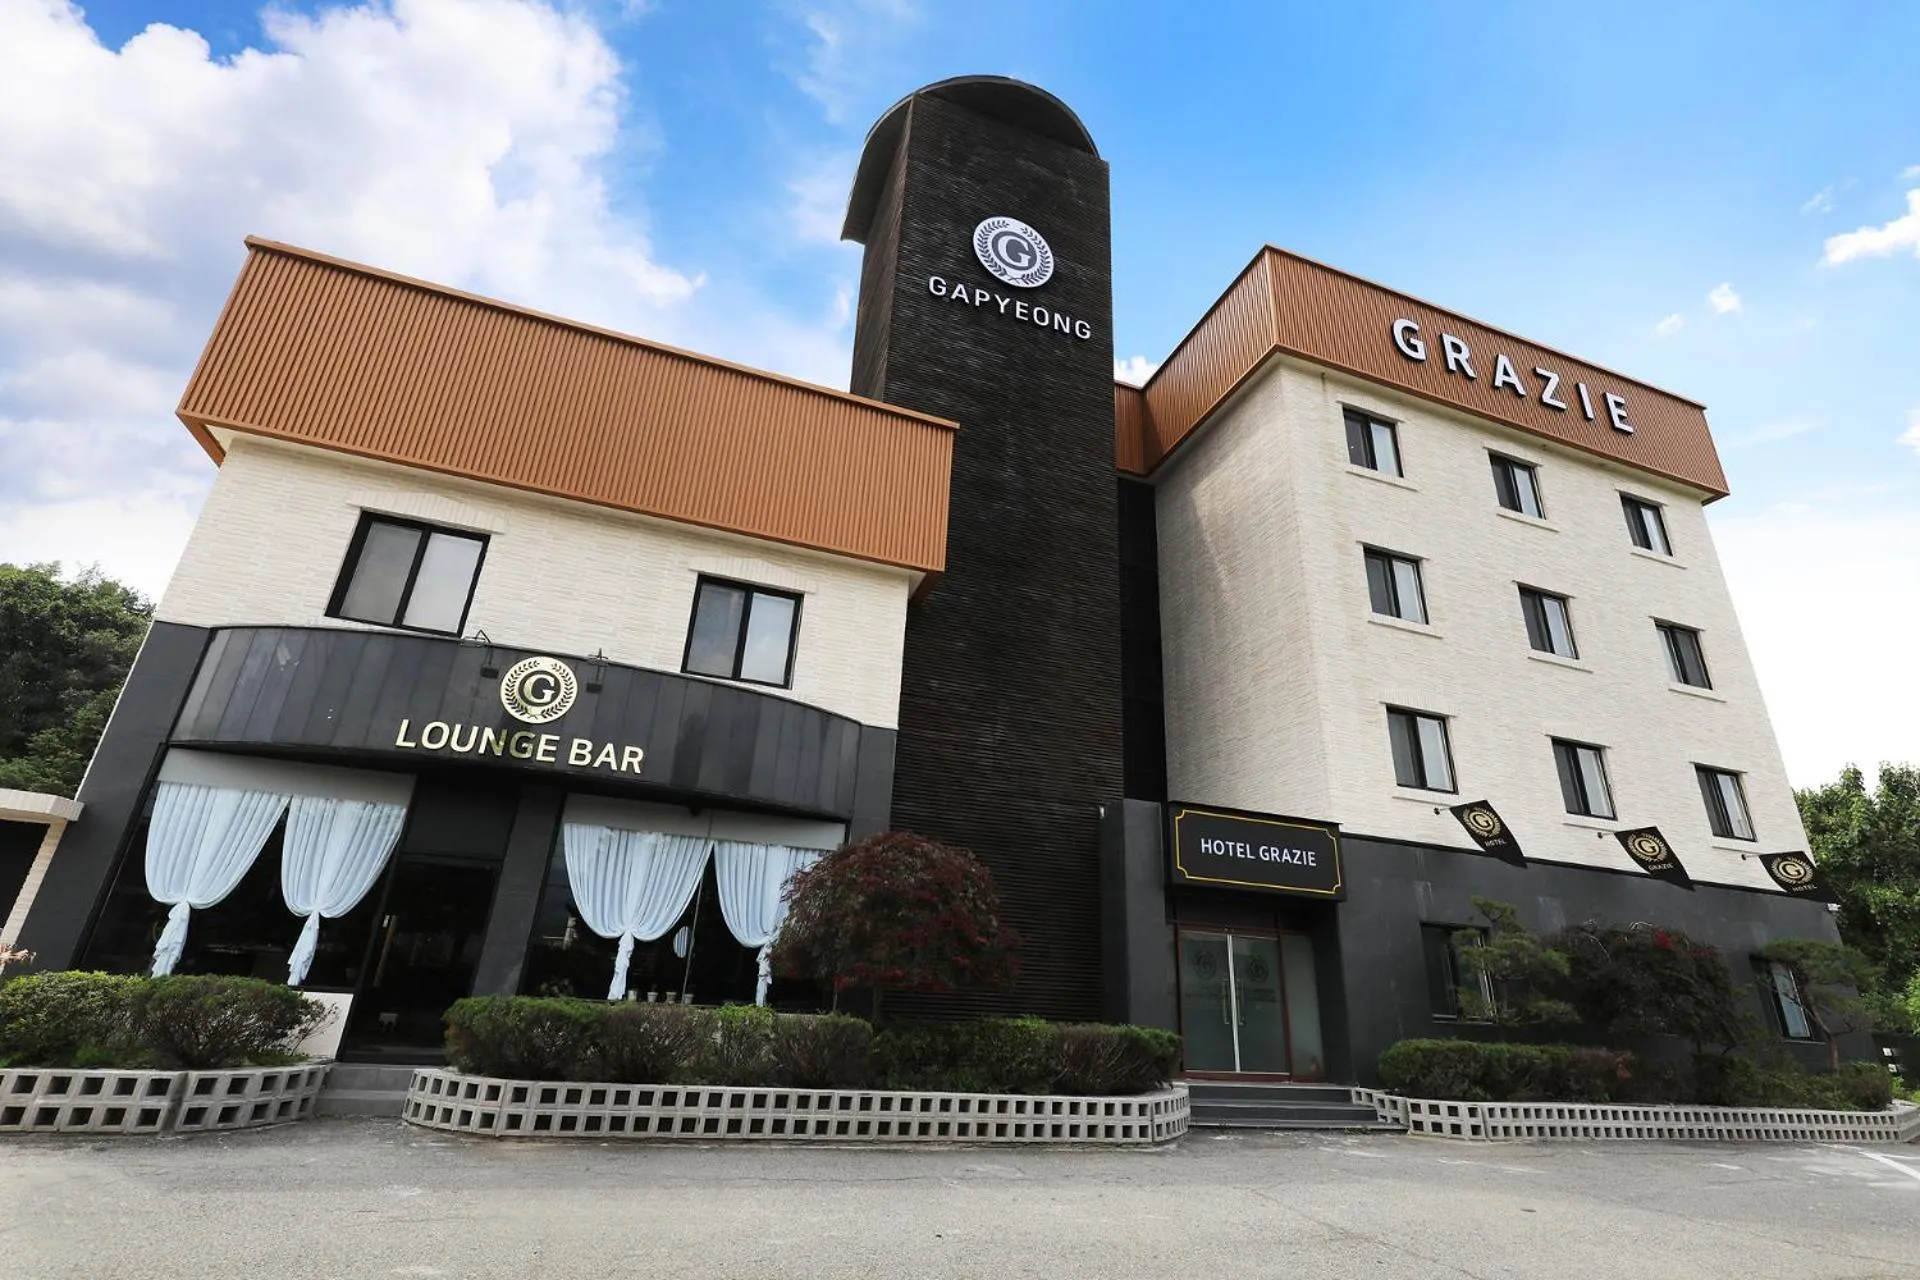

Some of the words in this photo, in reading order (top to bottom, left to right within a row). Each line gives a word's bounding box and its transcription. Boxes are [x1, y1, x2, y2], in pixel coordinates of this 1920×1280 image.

[997, 234, 1032, 268] G
[928, 276, 1091, 339] GAPYEONG
[1392, 318, 1634, 434] GRAZIE
[522, 674, 556, 703] G
[395, 718, 560, 762] LOUNGE
[568, 738, 645, 773] BAR
[1201, 838, 1256, 860] HOTEL
[1259, 845, 1317, 867] GRAZIE
